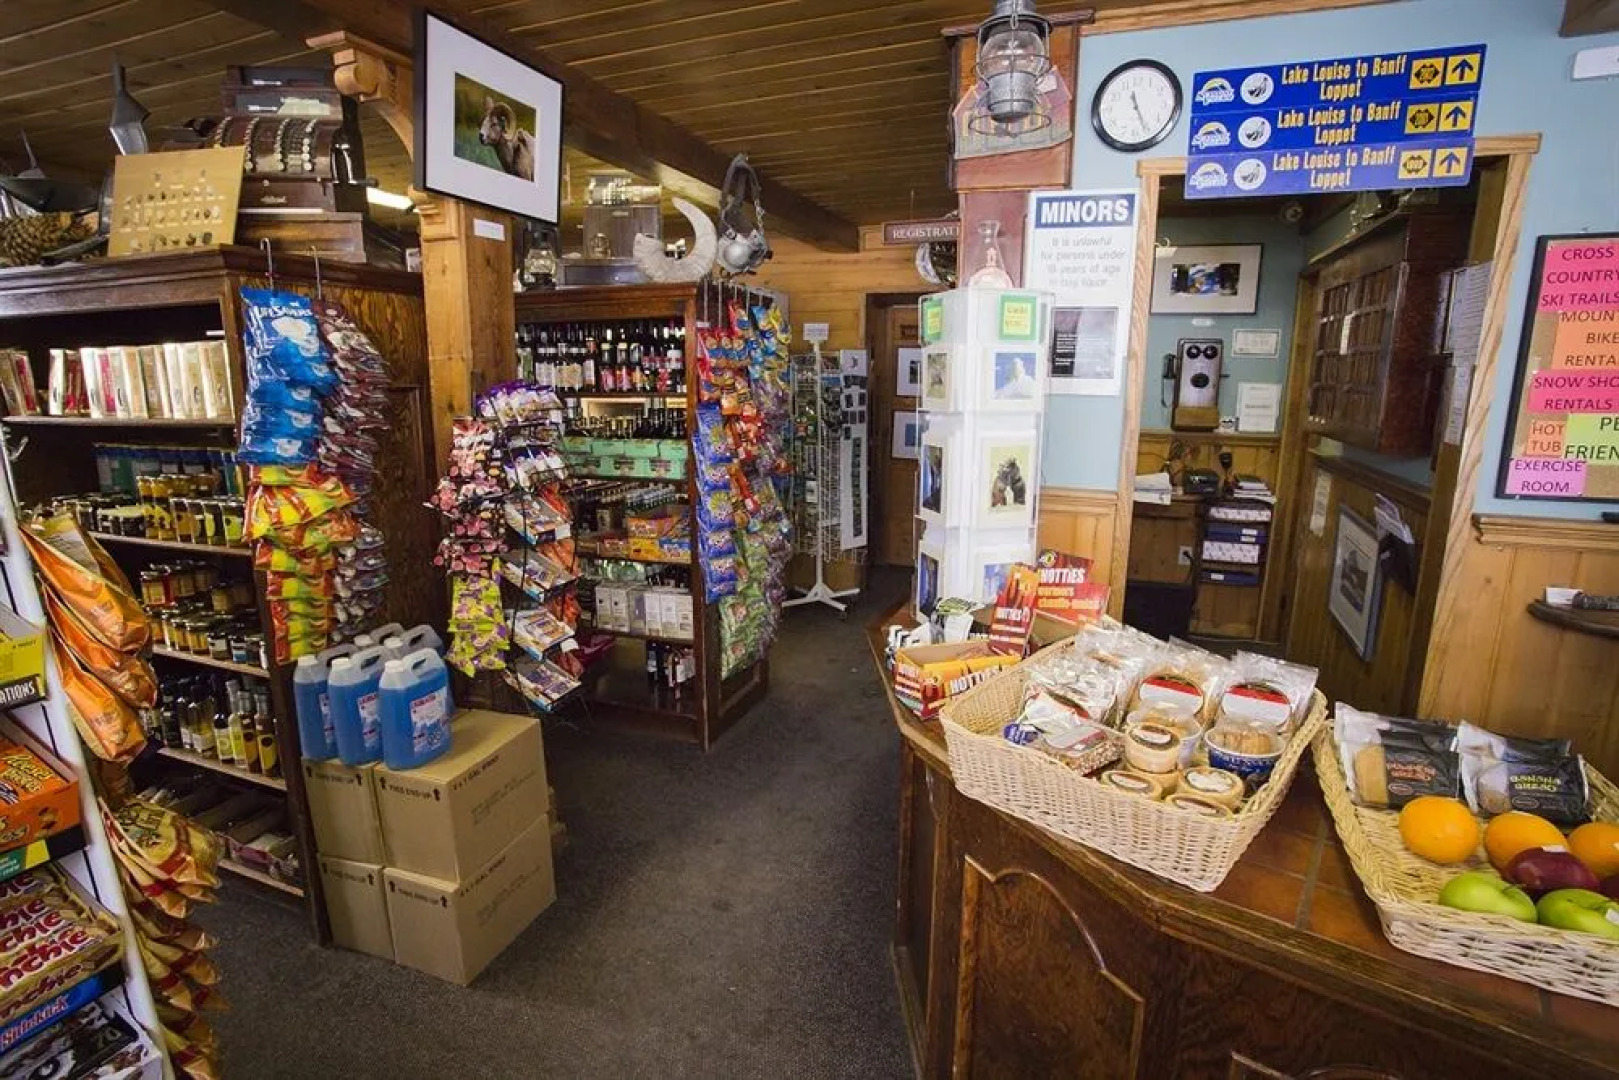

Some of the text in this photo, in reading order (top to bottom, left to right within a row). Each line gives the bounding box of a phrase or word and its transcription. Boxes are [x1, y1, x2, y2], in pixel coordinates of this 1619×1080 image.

[1281, 54, 1407, 84] Lake Louise to Banff
[1320, 79, 1360, 101] Loppet
[1277, 100, 1401, 128] Lake Louise to Banff
[1314, 124, 1356, 146] Loppet
[1273, 153, 1299, 171] Lake
[1303, 150, 1340, 170] Louise
[1346, 148, 1358, 165] to
[1362, 146, 1396, 166] Banff
[1310, 168, 1351, 190] Loppet
[1041, 199, 1129, 224] MINORS
[1562, 247, 1614, 261] CROSS
[1541, 294, 1564, 306] SKI
[1561, 310, 1619, 322] MOUN
[1586, 332, 1619, 344] BIKE
[1534, 376, 1584, 389] SNOW
[1544, 399, 1612, 410] RENTALS
[1532, 424, 1565, 435] HOT
[1531, 441, 1561, 452] TUB
[1515, 460, 1583, 472] EXERCISE
[1521, 481, 1570, 492] ROOM
